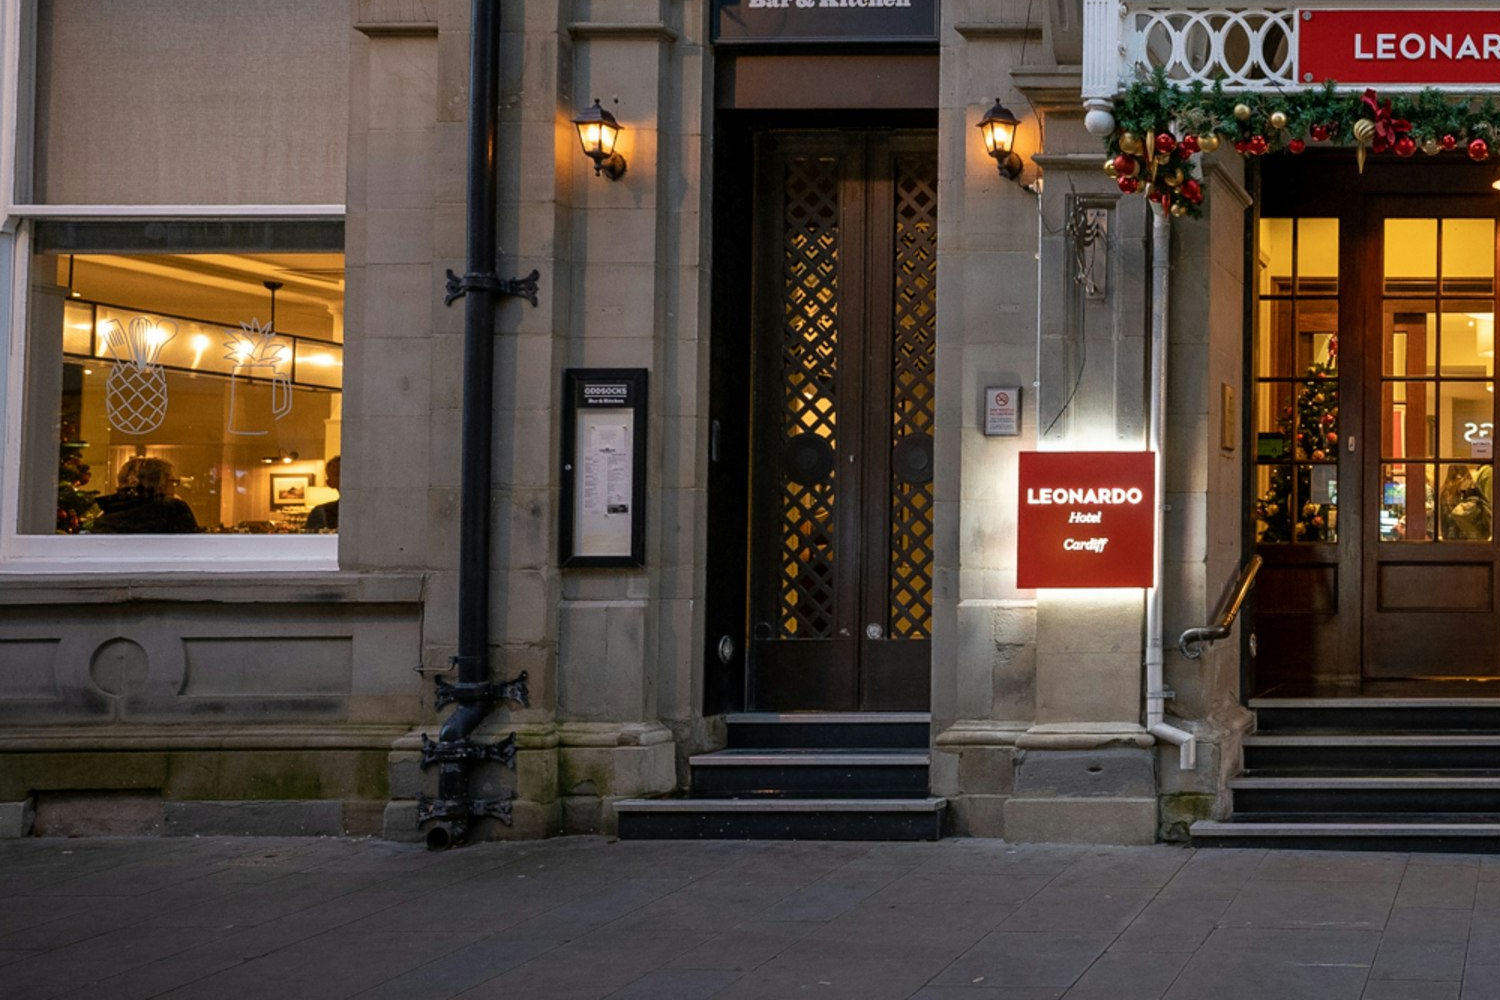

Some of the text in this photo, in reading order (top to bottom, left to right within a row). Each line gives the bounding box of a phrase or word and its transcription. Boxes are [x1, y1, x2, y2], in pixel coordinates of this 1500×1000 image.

[1027, 487, 1143, 505] LEONARDO
[1068, 511, 1102, 524] Hotel
[1063, 538, 1109, 554] Cardiff
